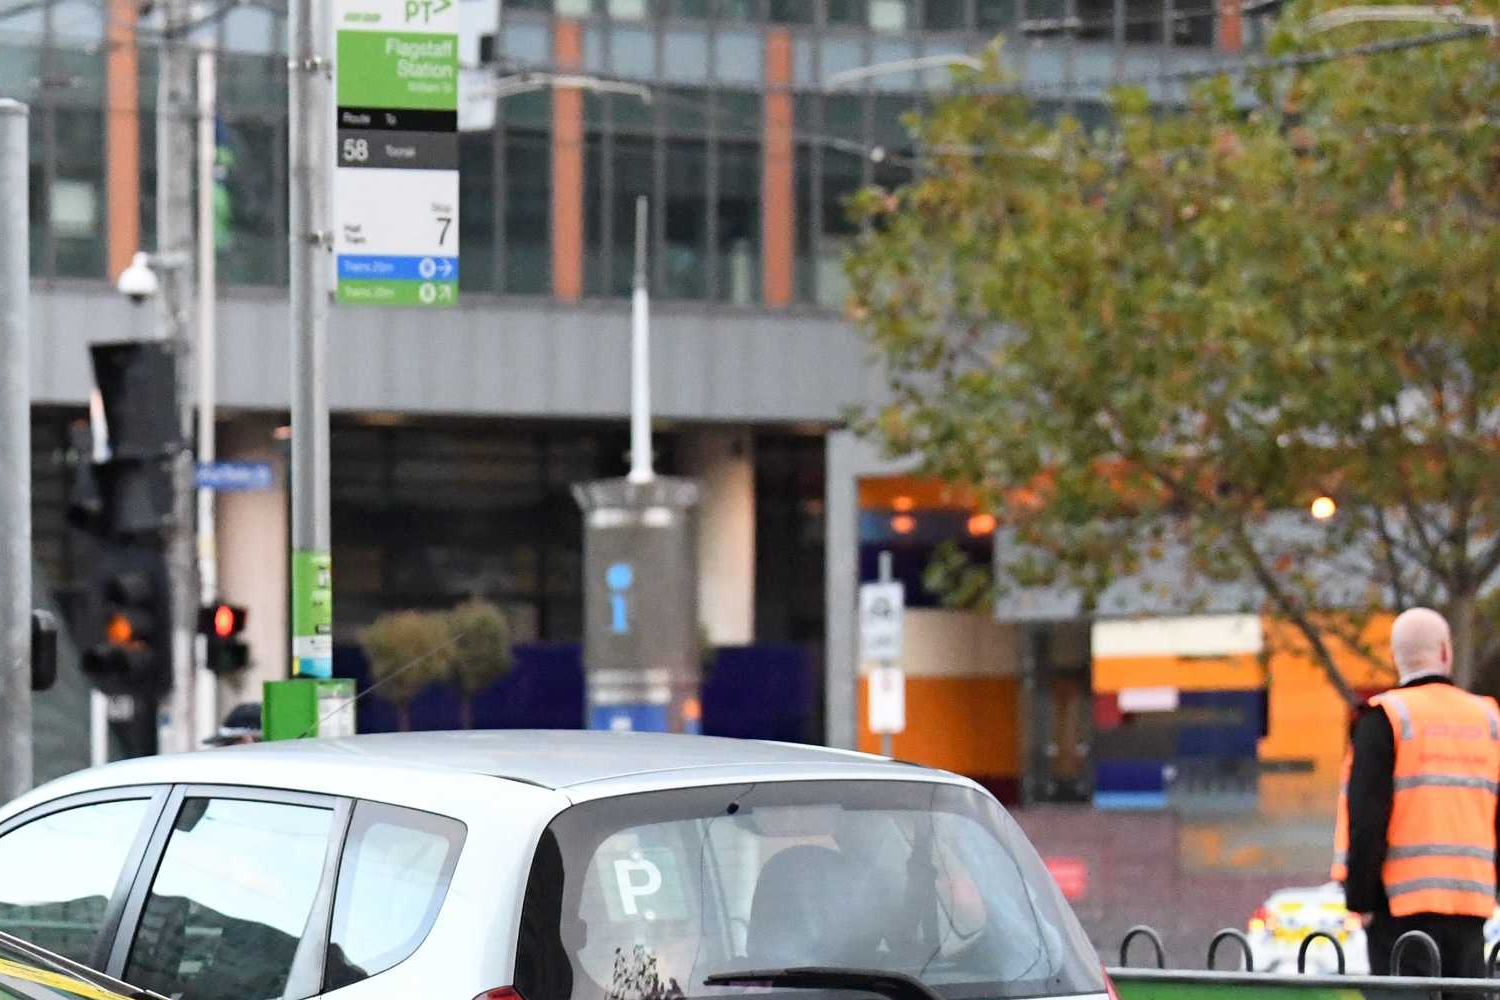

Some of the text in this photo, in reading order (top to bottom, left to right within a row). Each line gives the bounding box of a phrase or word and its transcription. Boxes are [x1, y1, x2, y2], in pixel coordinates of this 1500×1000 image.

[386, 38, 453, 60] Flagstaff
[397, 59, 453, 79] Station
[343, 138, 369, 161] 58
[436, 217, 452, 245] 7
[613, 859, 662, 915] P
